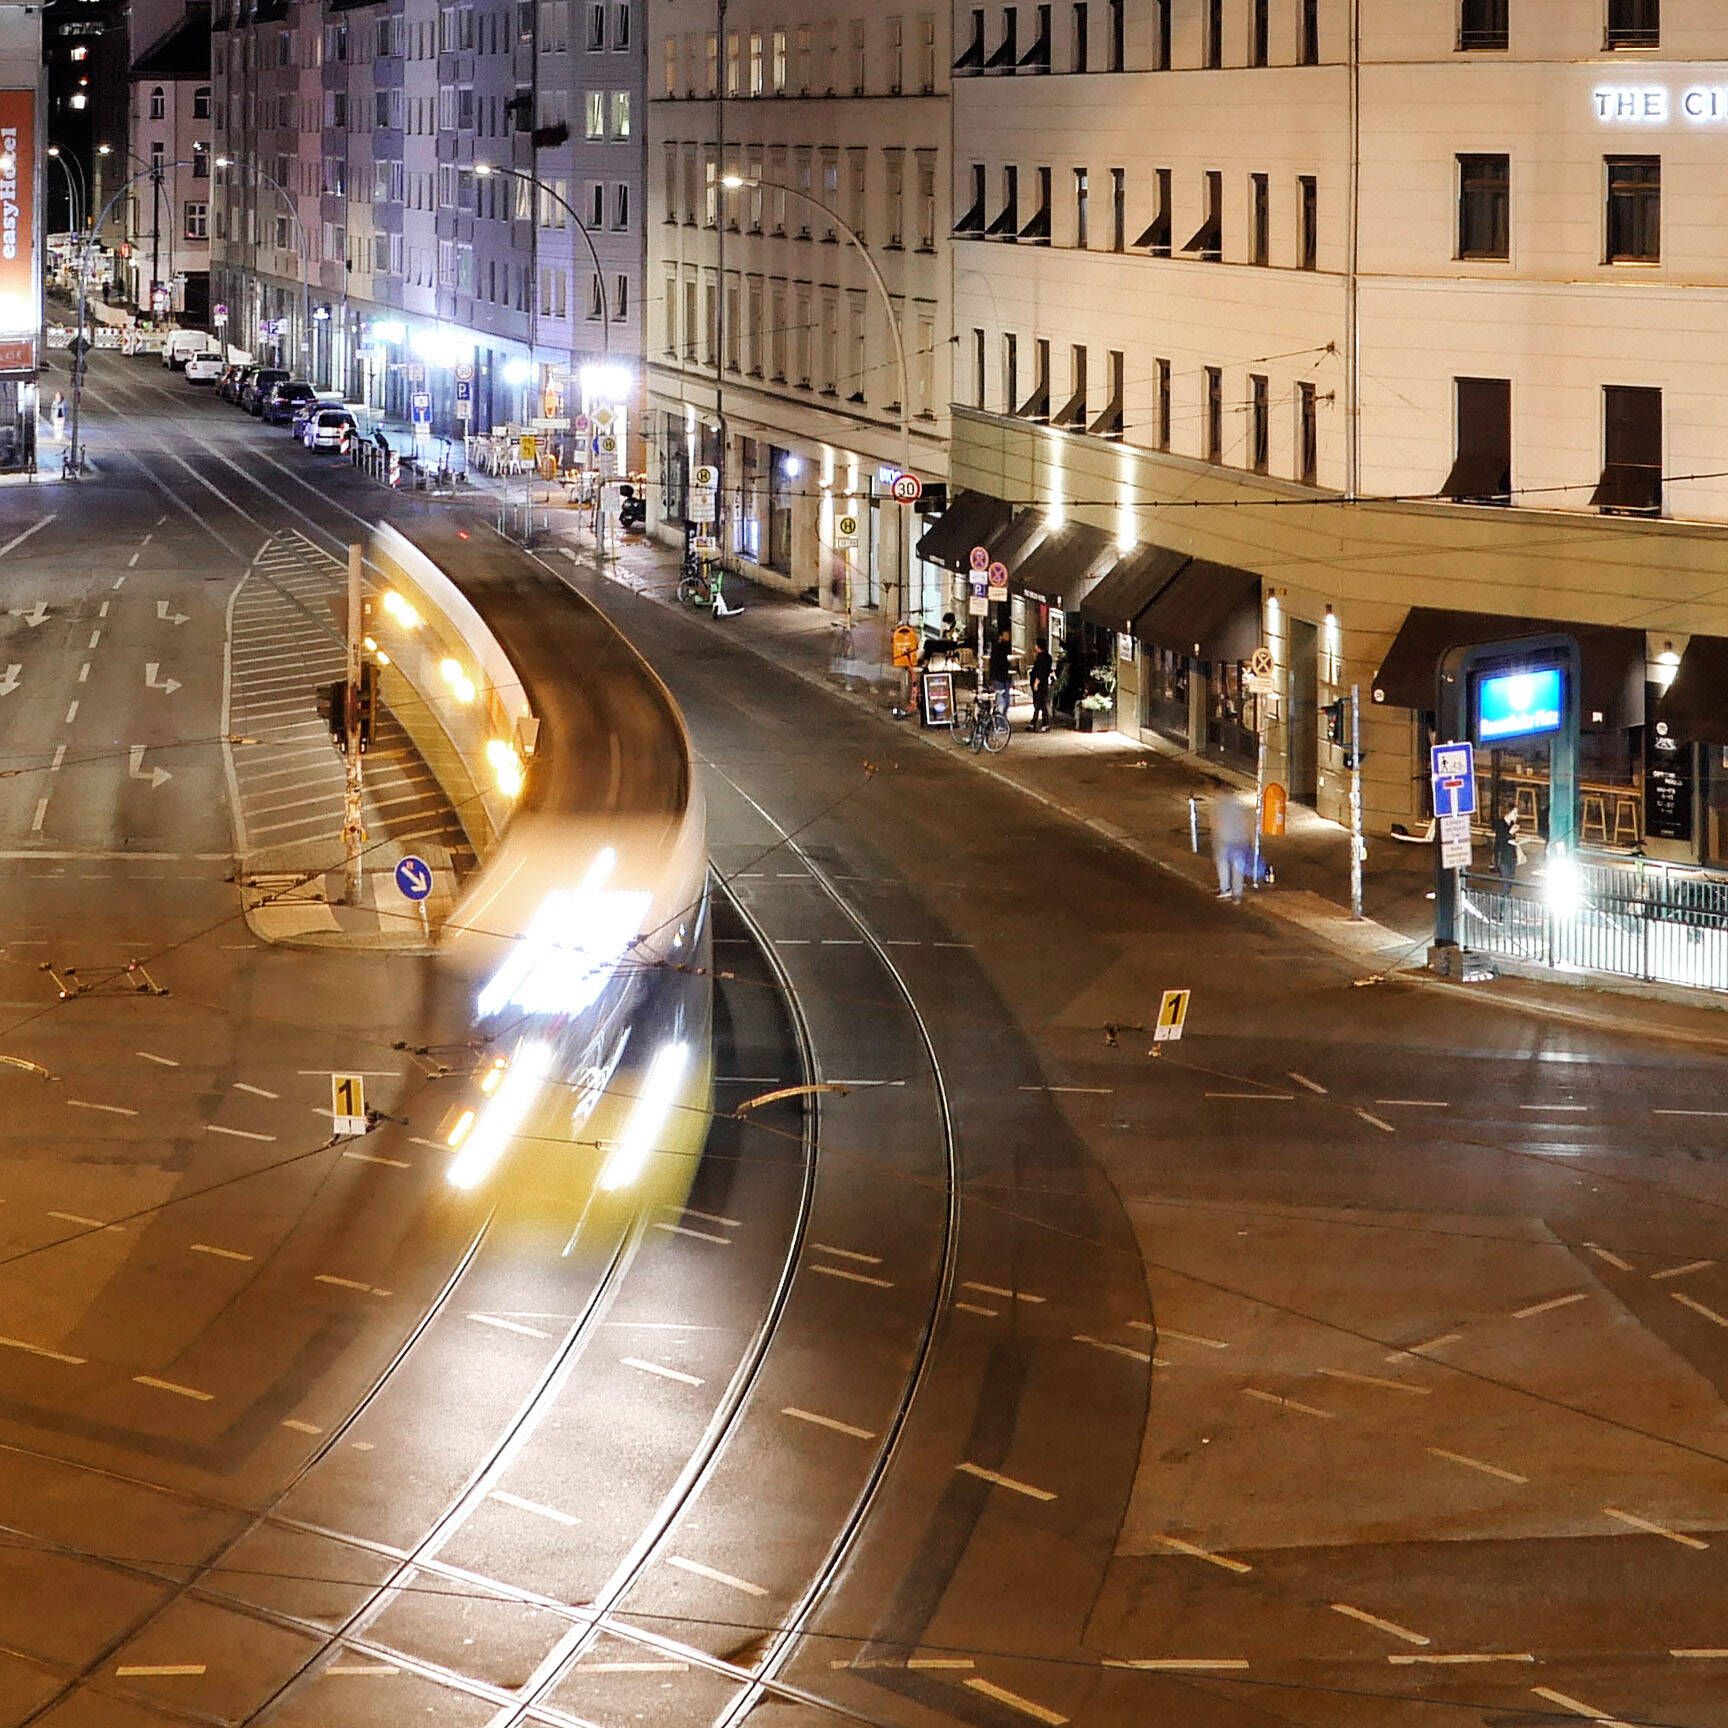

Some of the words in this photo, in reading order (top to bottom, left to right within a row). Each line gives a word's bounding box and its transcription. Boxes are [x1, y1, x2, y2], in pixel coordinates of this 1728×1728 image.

[1595, 92, 1661, 116] THE
[898, 482, 915, 497] 30
[1167, 993, 1182, 1025] 1
[338, 1079, 353, 1116] 1
